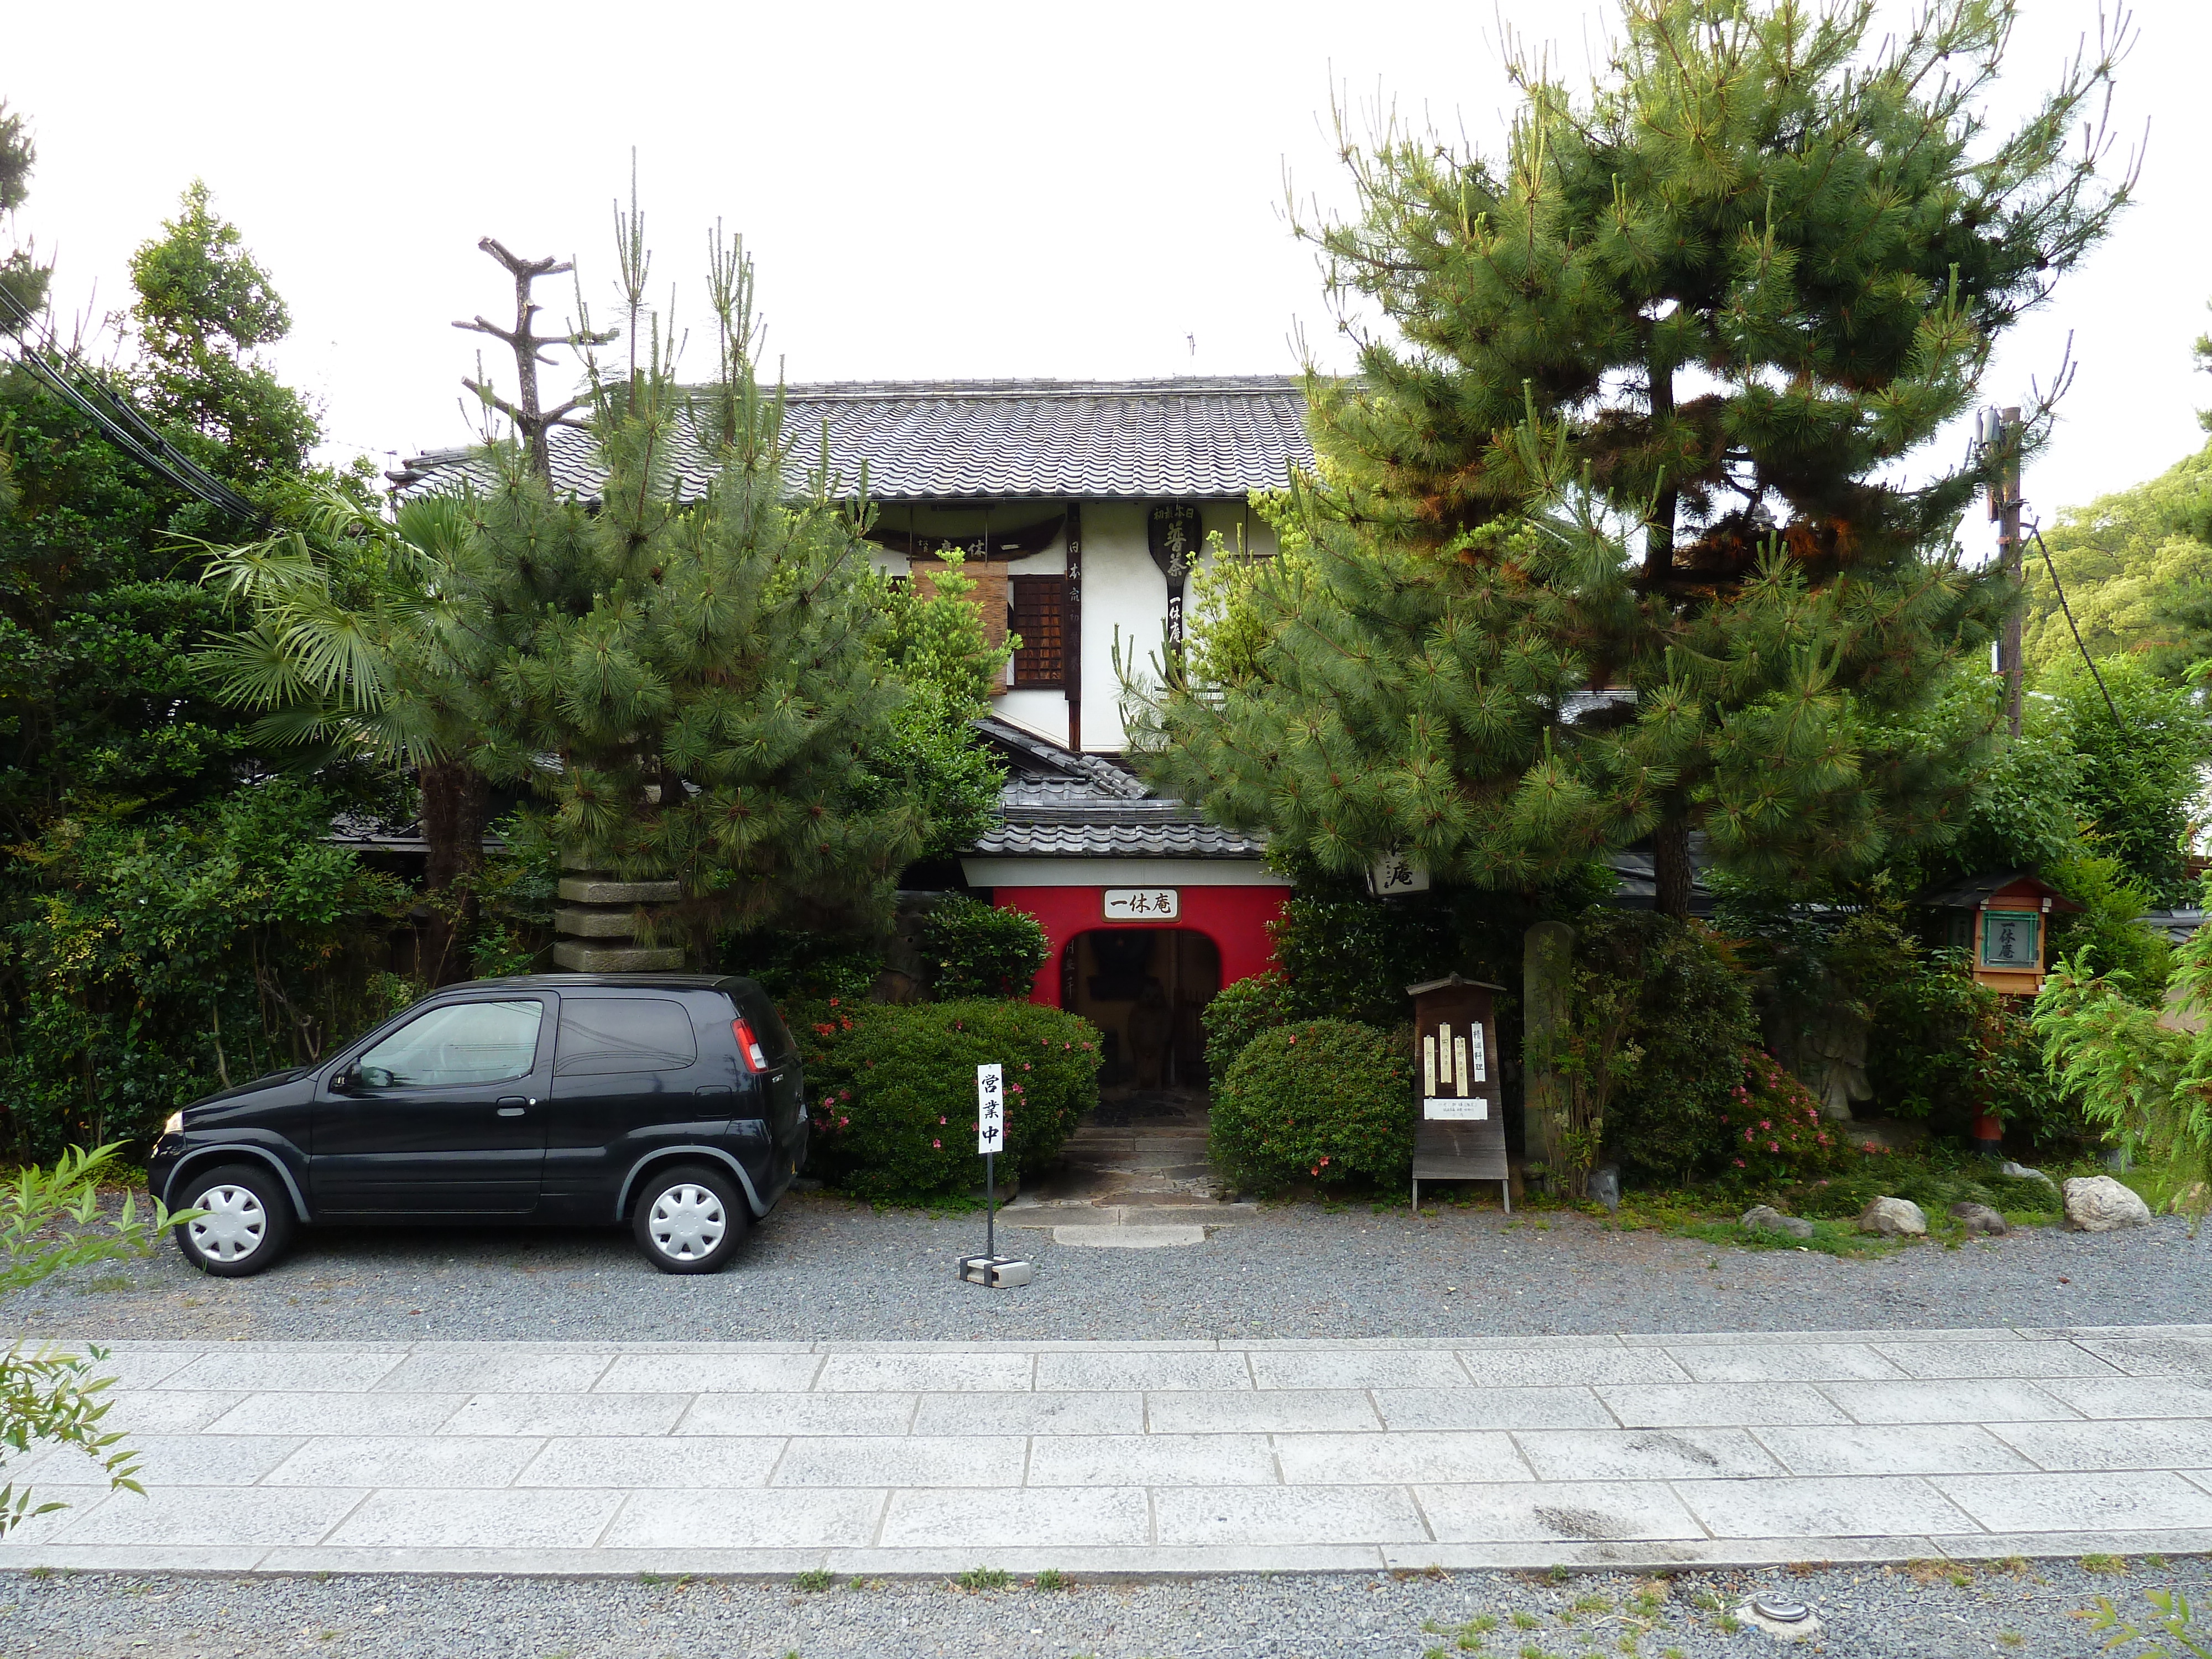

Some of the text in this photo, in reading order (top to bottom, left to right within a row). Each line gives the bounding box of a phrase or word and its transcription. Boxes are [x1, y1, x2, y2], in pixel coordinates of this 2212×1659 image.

[1169, 597, 1181, 643] 一休庵
[1110, 893, 1171, 914] 一休庵
[1999, 922, 2016, 958] 一休庵
[1473, 1030, 1484, 1071] 精進料理
[982, 1074, 1000, 1144] 営業中
